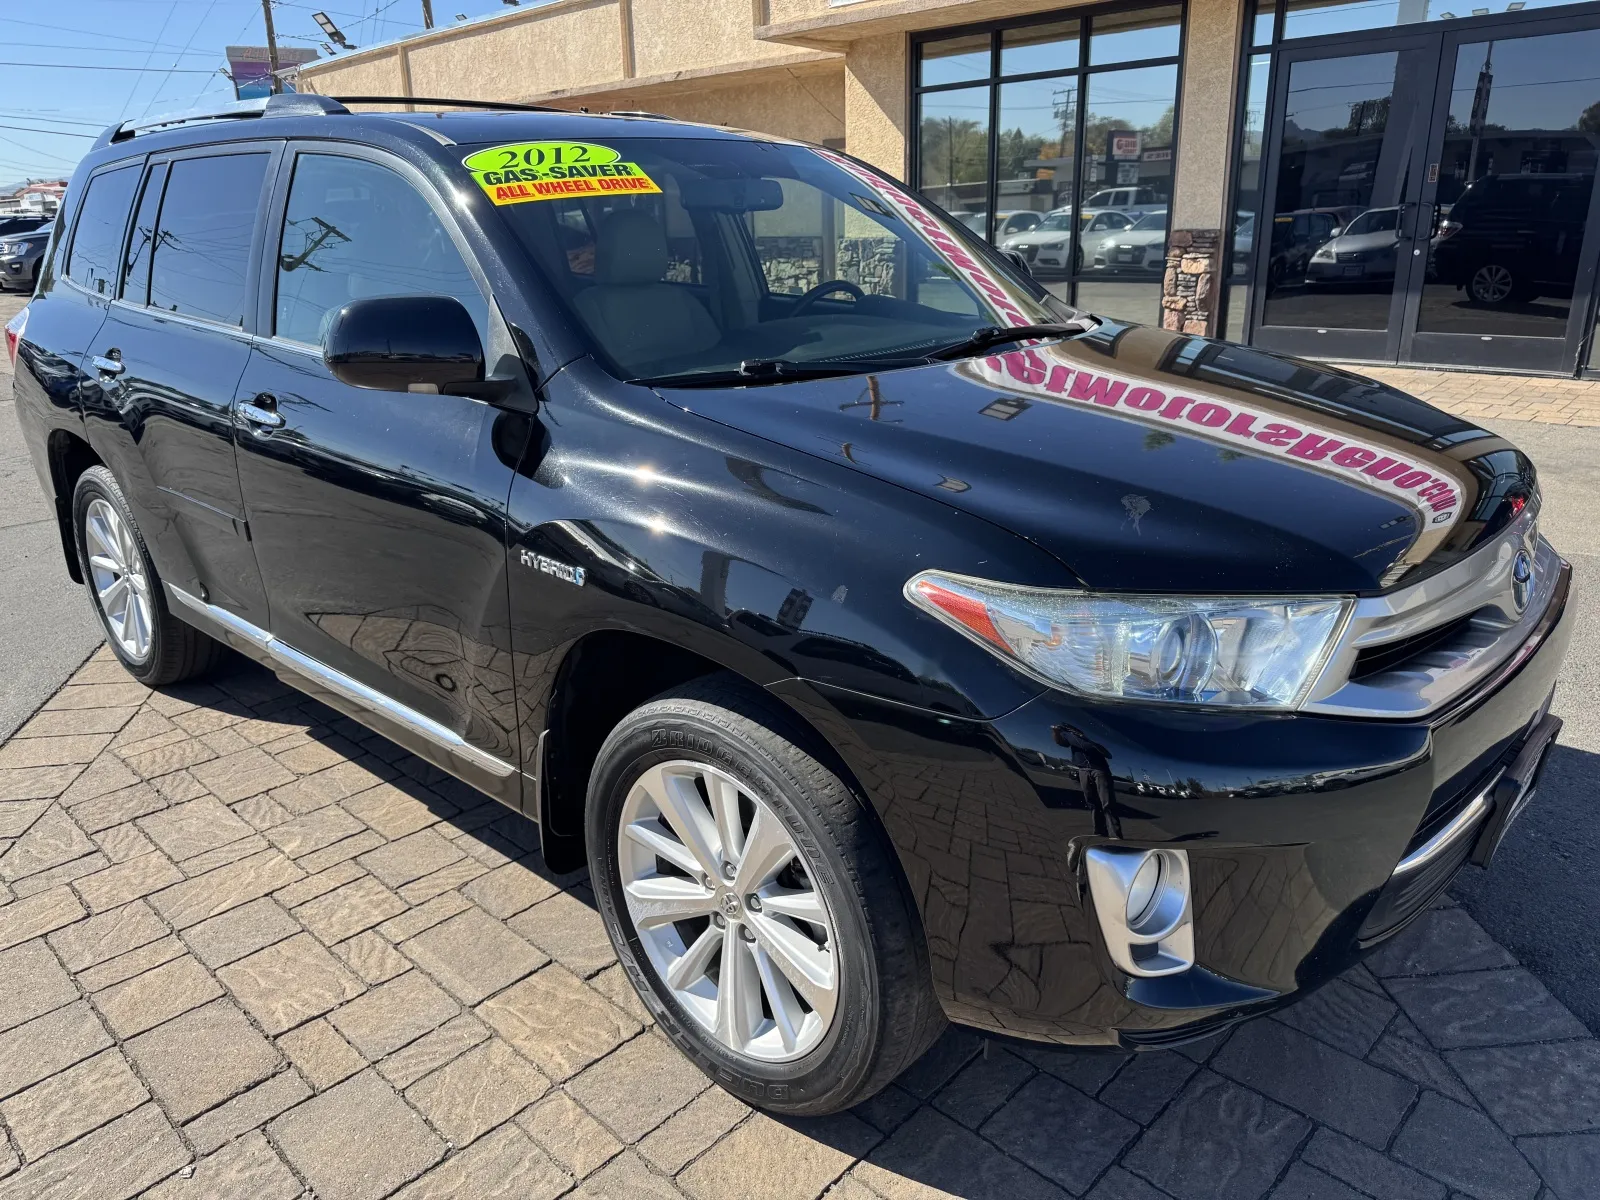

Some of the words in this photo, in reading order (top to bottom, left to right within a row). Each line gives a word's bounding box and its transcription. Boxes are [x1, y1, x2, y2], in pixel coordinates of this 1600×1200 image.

[498, 145, 591, 169] 2012
[483, 164, 633, 186] GAS-SAVER
[496, 183, 532, 200] ALL
[533, 179, 597, 195] WHEEL
[599, 177, 650, 190] DRIVE
[520, 549, 577, 583] HYBRID
[651, 728, 834, 885] BRIDGESTONE
